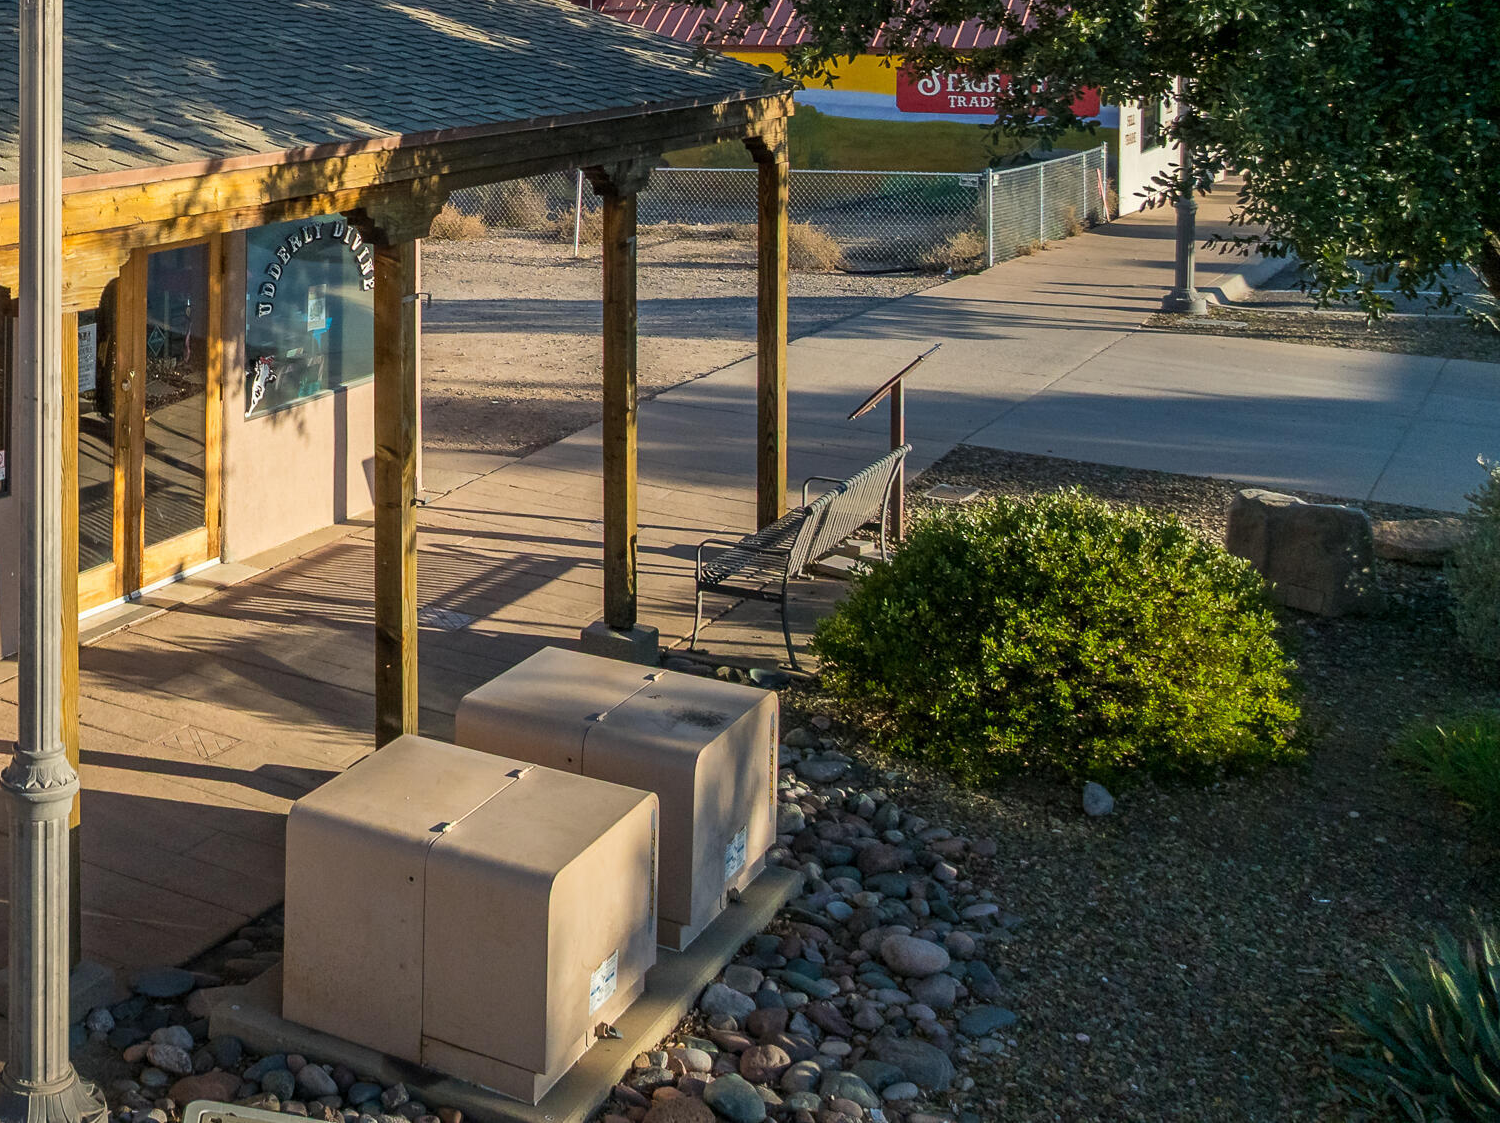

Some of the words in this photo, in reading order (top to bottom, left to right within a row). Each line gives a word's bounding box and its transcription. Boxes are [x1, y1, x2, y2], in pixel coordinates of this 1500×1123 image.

[947, 95, 1003, 109] TRAD
[258, 222, 323, 318] UDDERLY
[333, 220, 375, 292] DIVINE
